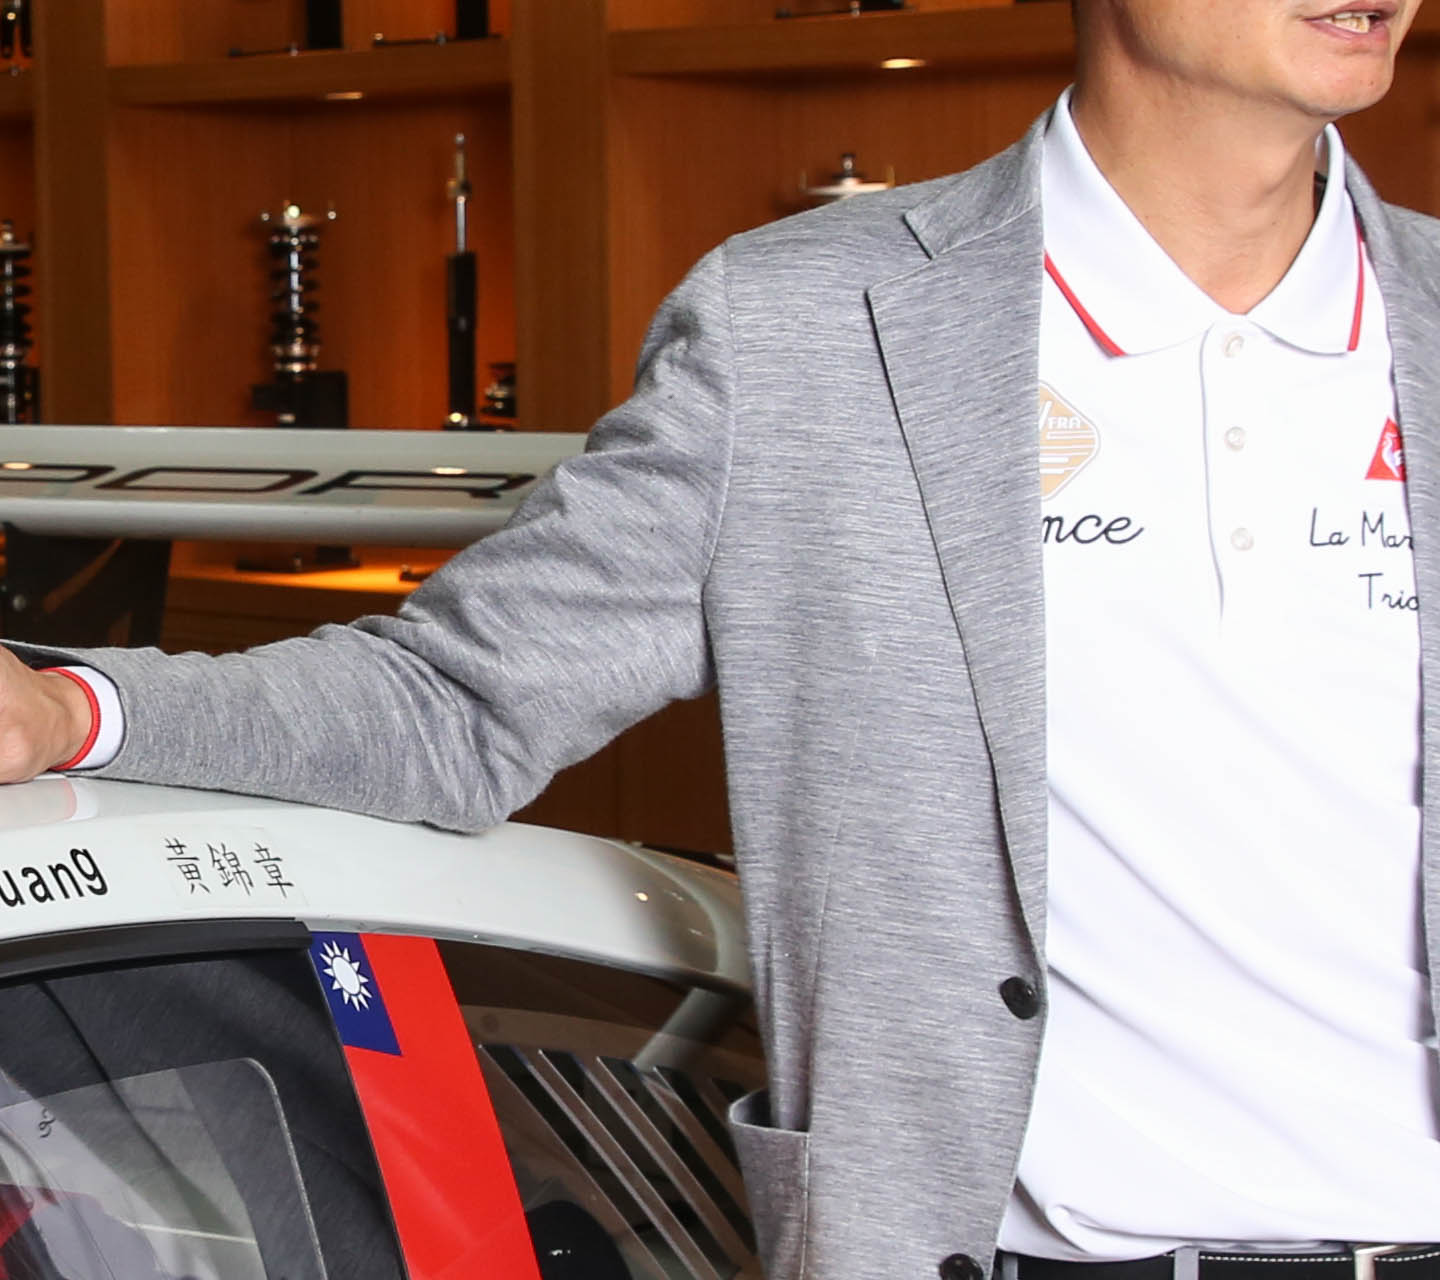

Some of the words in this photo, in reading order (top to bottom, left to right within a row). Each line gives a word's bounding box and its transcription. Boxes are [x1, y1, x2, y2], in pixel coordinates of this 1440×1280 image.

[1309, 507, 1351, 548] La
[163, 836, 295, 901] 黃錦章
